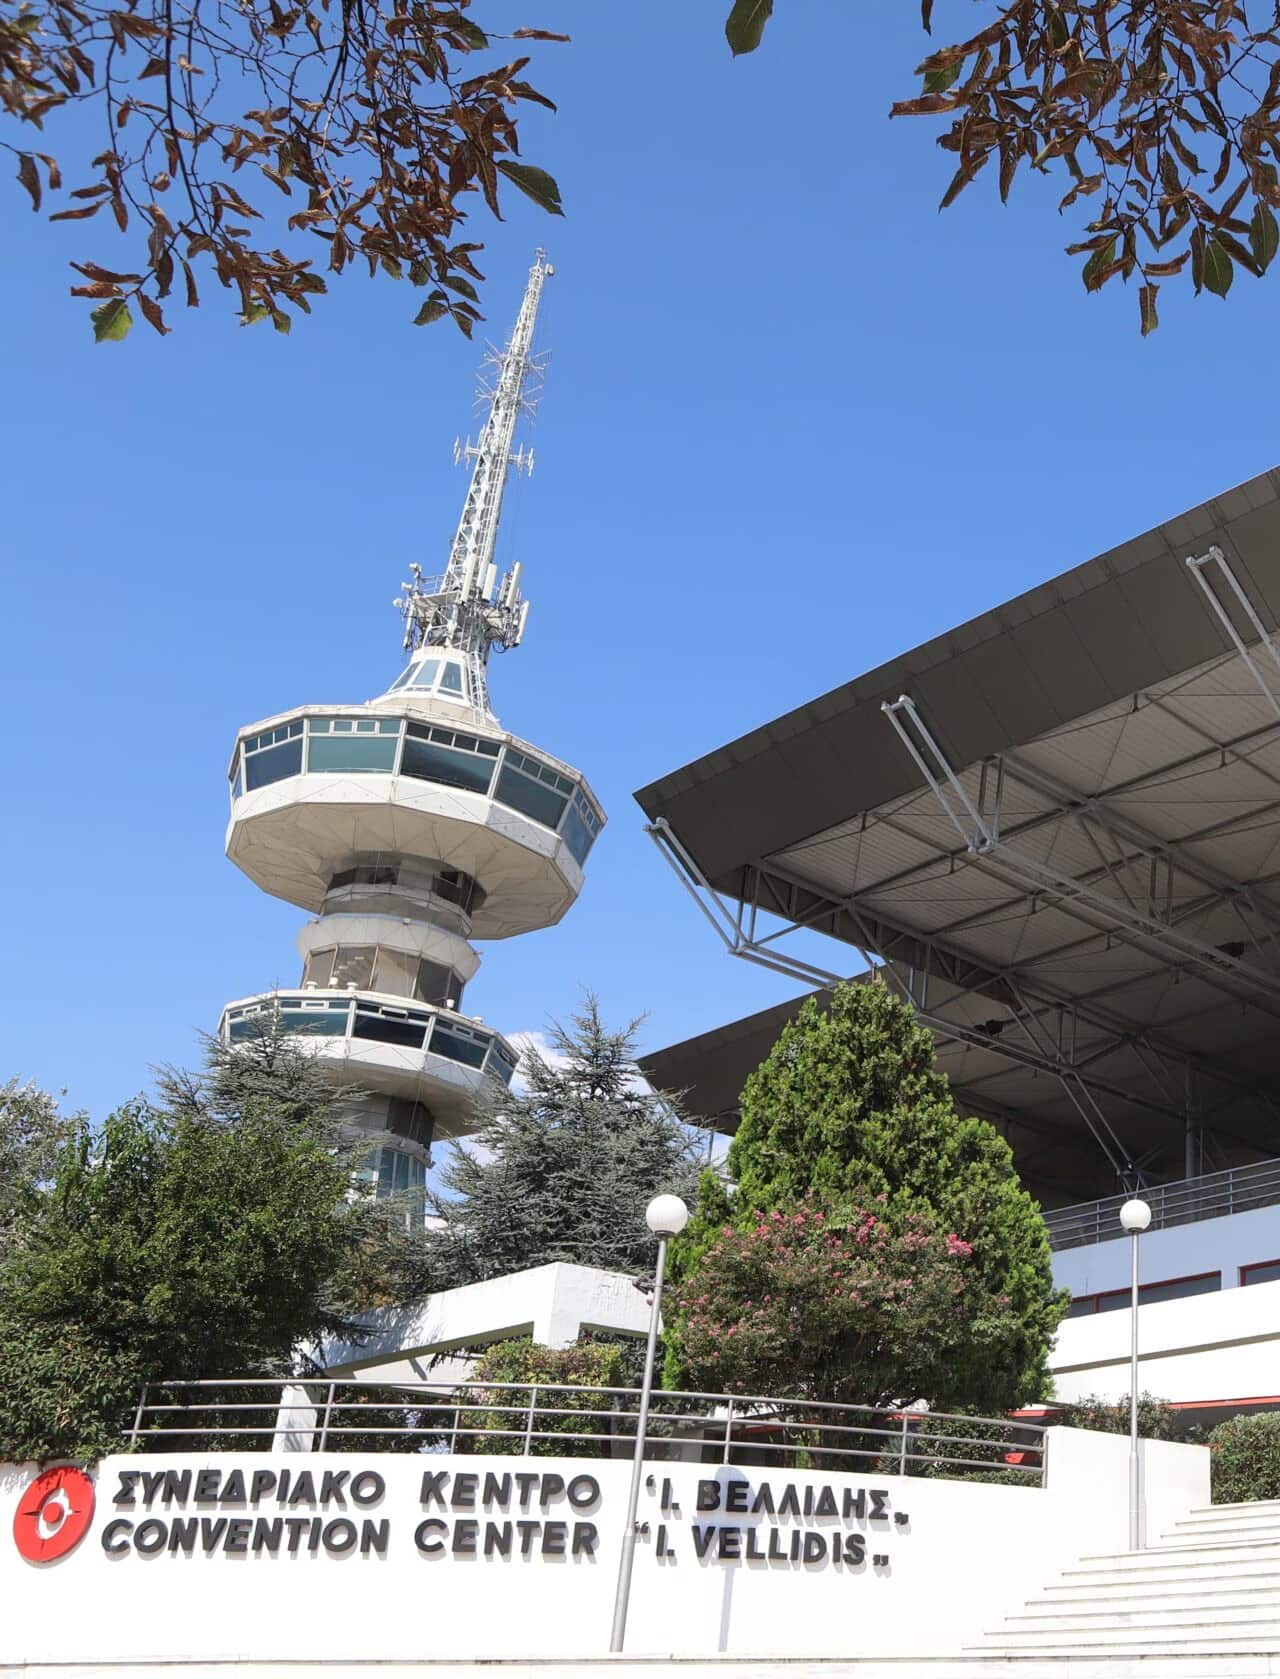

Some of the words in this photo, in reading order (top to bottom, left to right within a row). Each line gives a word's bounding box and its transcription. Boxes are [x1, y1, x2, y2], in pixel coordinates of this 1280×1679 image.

[112, 1469, 386, 1504] ΣΥΝΕΔΡΙΑΚΟ
[419, 1471, 600, 1507] ΚΕΝΤΡΟ
[101, 1517, 390, 1553] CONVENTION
[414, 1518, 598, 1555] CENTER
